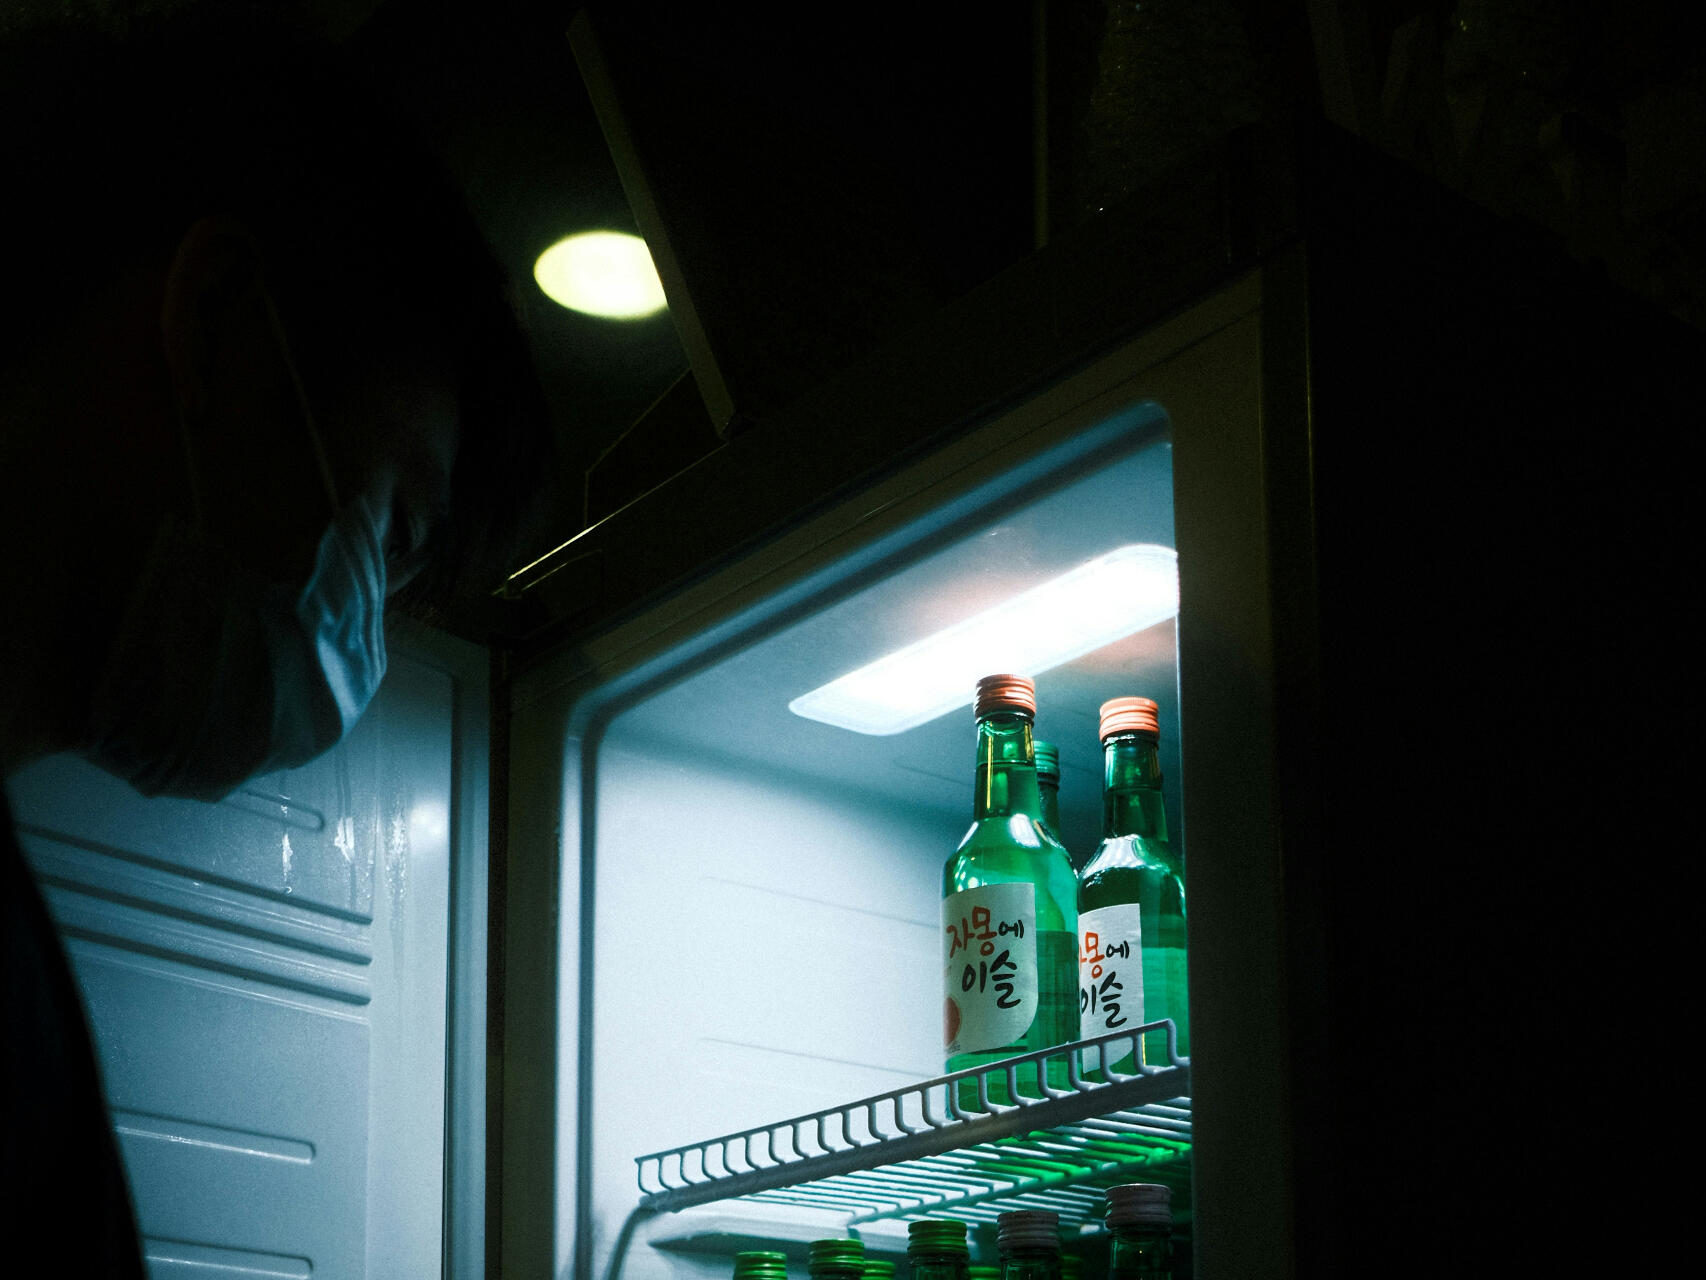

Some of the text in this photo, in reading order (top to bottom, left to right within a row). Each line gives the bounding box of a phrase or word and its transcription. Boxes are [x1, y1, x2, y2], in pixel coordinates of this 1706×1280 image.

[946, 905, 1025, 958] 자몽에
[962, 949, 1021, 1010] 이슬
[1080, 971, 1127, 1029] 이슬
